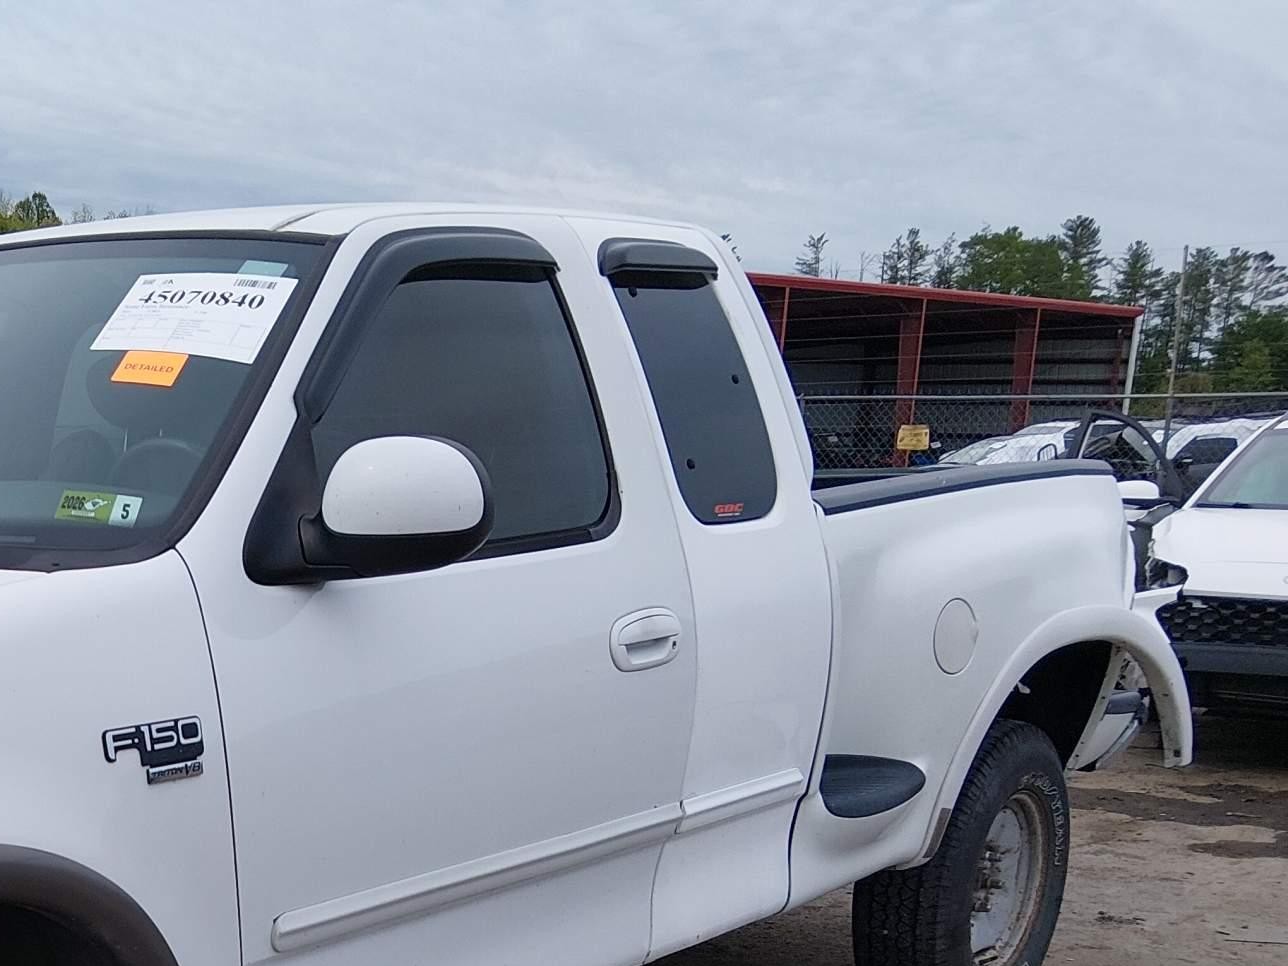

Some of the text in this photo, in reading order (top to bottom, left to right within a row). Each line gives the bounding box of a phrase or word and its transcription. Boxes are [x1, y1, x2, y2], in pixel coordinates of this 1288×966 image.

[138, 290, 265, 310] 45070840
[124, 363, 174, 373] DETAILED
[61, 496, 86, 510] 2026
[120, 503, 131, 519] 5
[185, 762, 201, 776] V8
